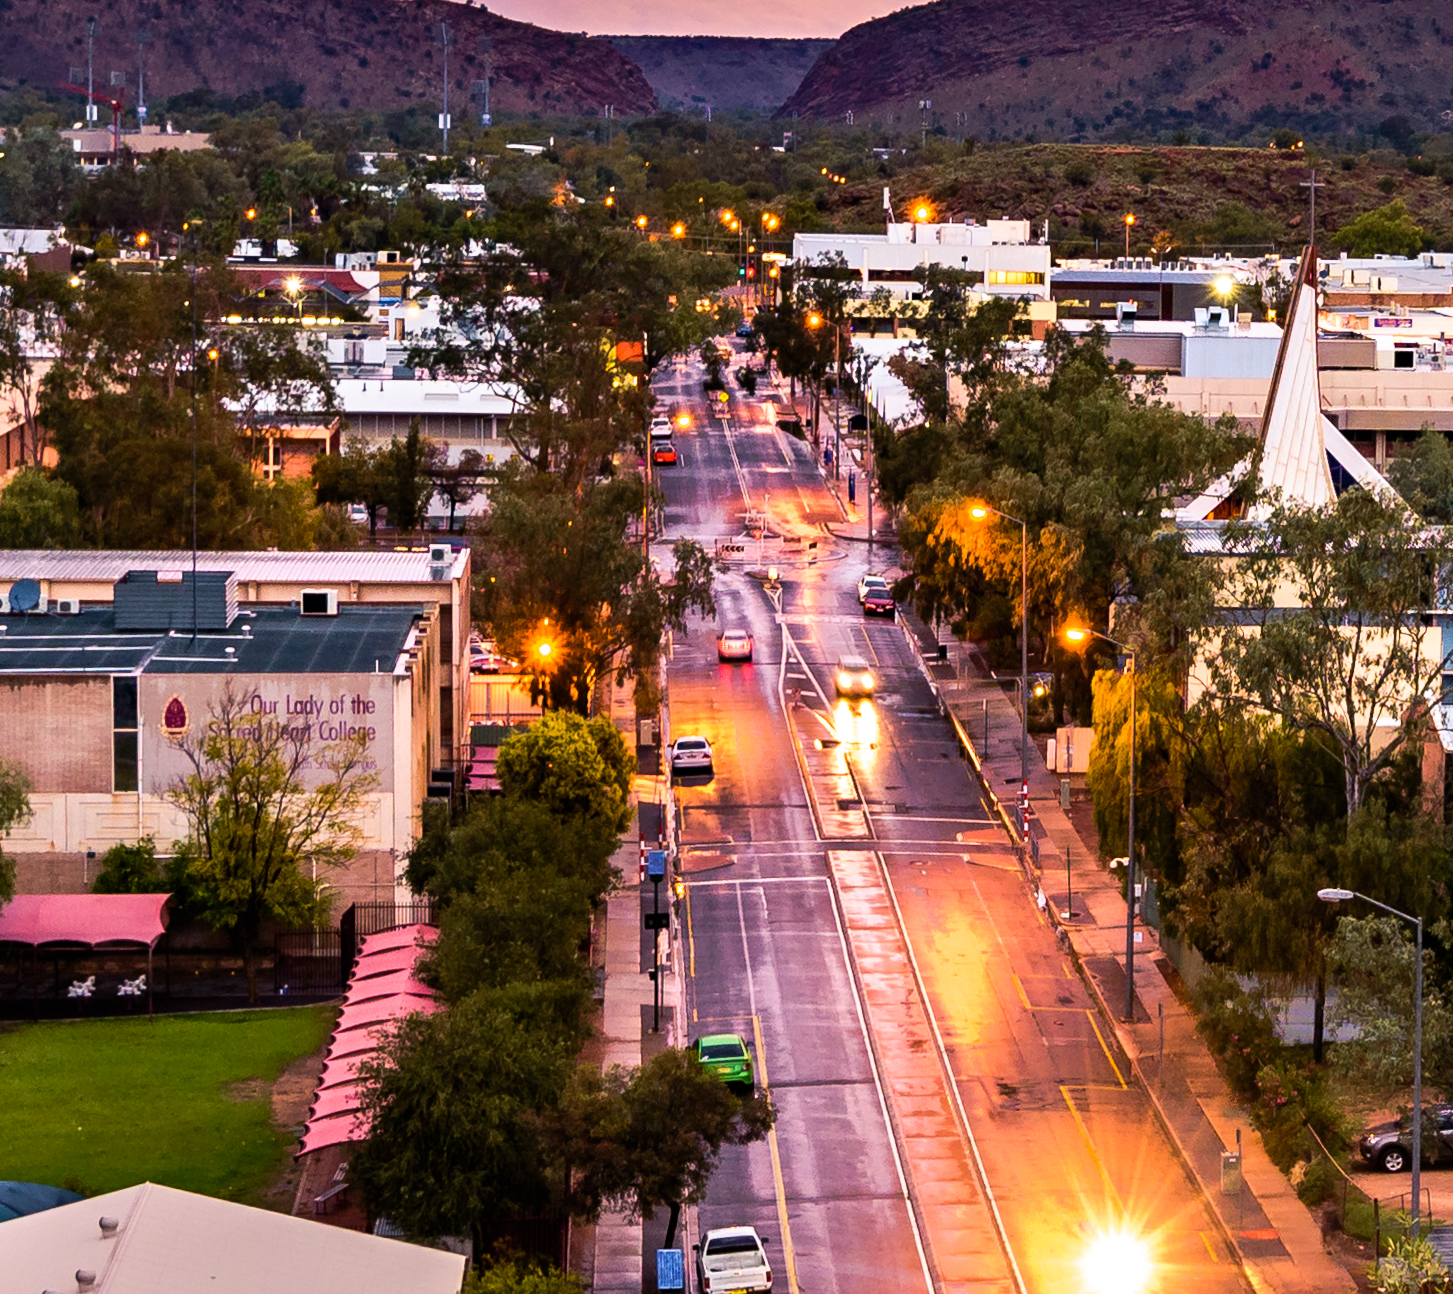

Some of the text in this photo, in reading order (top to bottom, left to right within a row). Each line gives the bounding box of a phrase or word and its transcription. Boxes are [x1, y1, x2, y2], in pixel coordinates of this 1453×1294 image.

[250, 693, 376, 720] Our Lady of the
[208, 721, 262, 742] Sared
[318, 720, 377, 747] College
